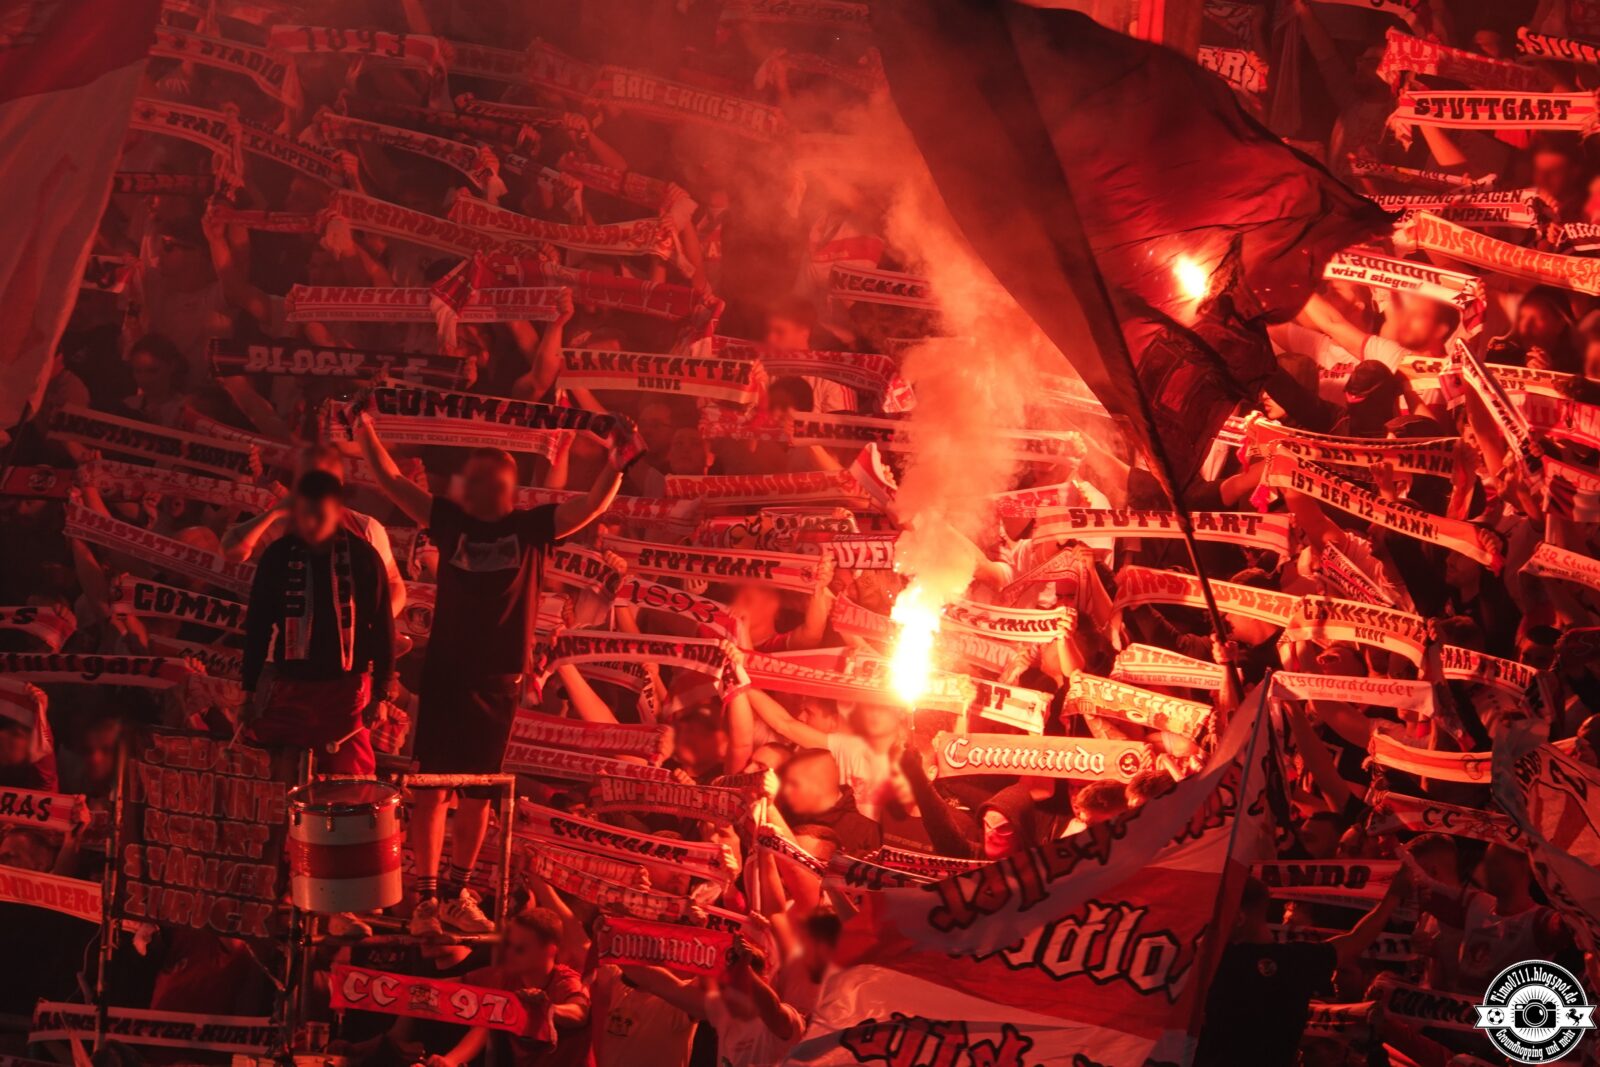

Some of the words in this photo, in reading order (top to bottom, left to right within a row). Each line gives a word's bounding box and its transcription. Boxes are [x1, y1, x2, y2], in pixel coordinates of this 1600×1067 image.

[1414, 97, 1571, 121] STUTTGART
[1332, 266, 1365, 280] wird
[245, 345, 366, 377] BLOCK
[561, 349, 754, 386] CANNSTATTER
[637, 376, 682, 391] KURVE
[375, 386, 618, 436] COMMANDO
[1398, 453, 1453, 474] MANN
[1067, 508, 1263, 536] STUTTART
[1290, 469, 1313, 492] IST
[1320, 482, 1351, 508] DER
[1384, 509, 1440, 541] MANN!
[629, 580, 720, 624] 1893
[1303, 598, 1426, 644] CANNSTATTE
[943, 737, 1106, 775] Commando
[1423, 806, 1461, 829] CC
[550, 817, 689, 863] STUTTGART
[1261, 865, 1371, 889] ANDO
[342, 970, 401, 1007] CC
[450, 987, 511, 1024] 97
